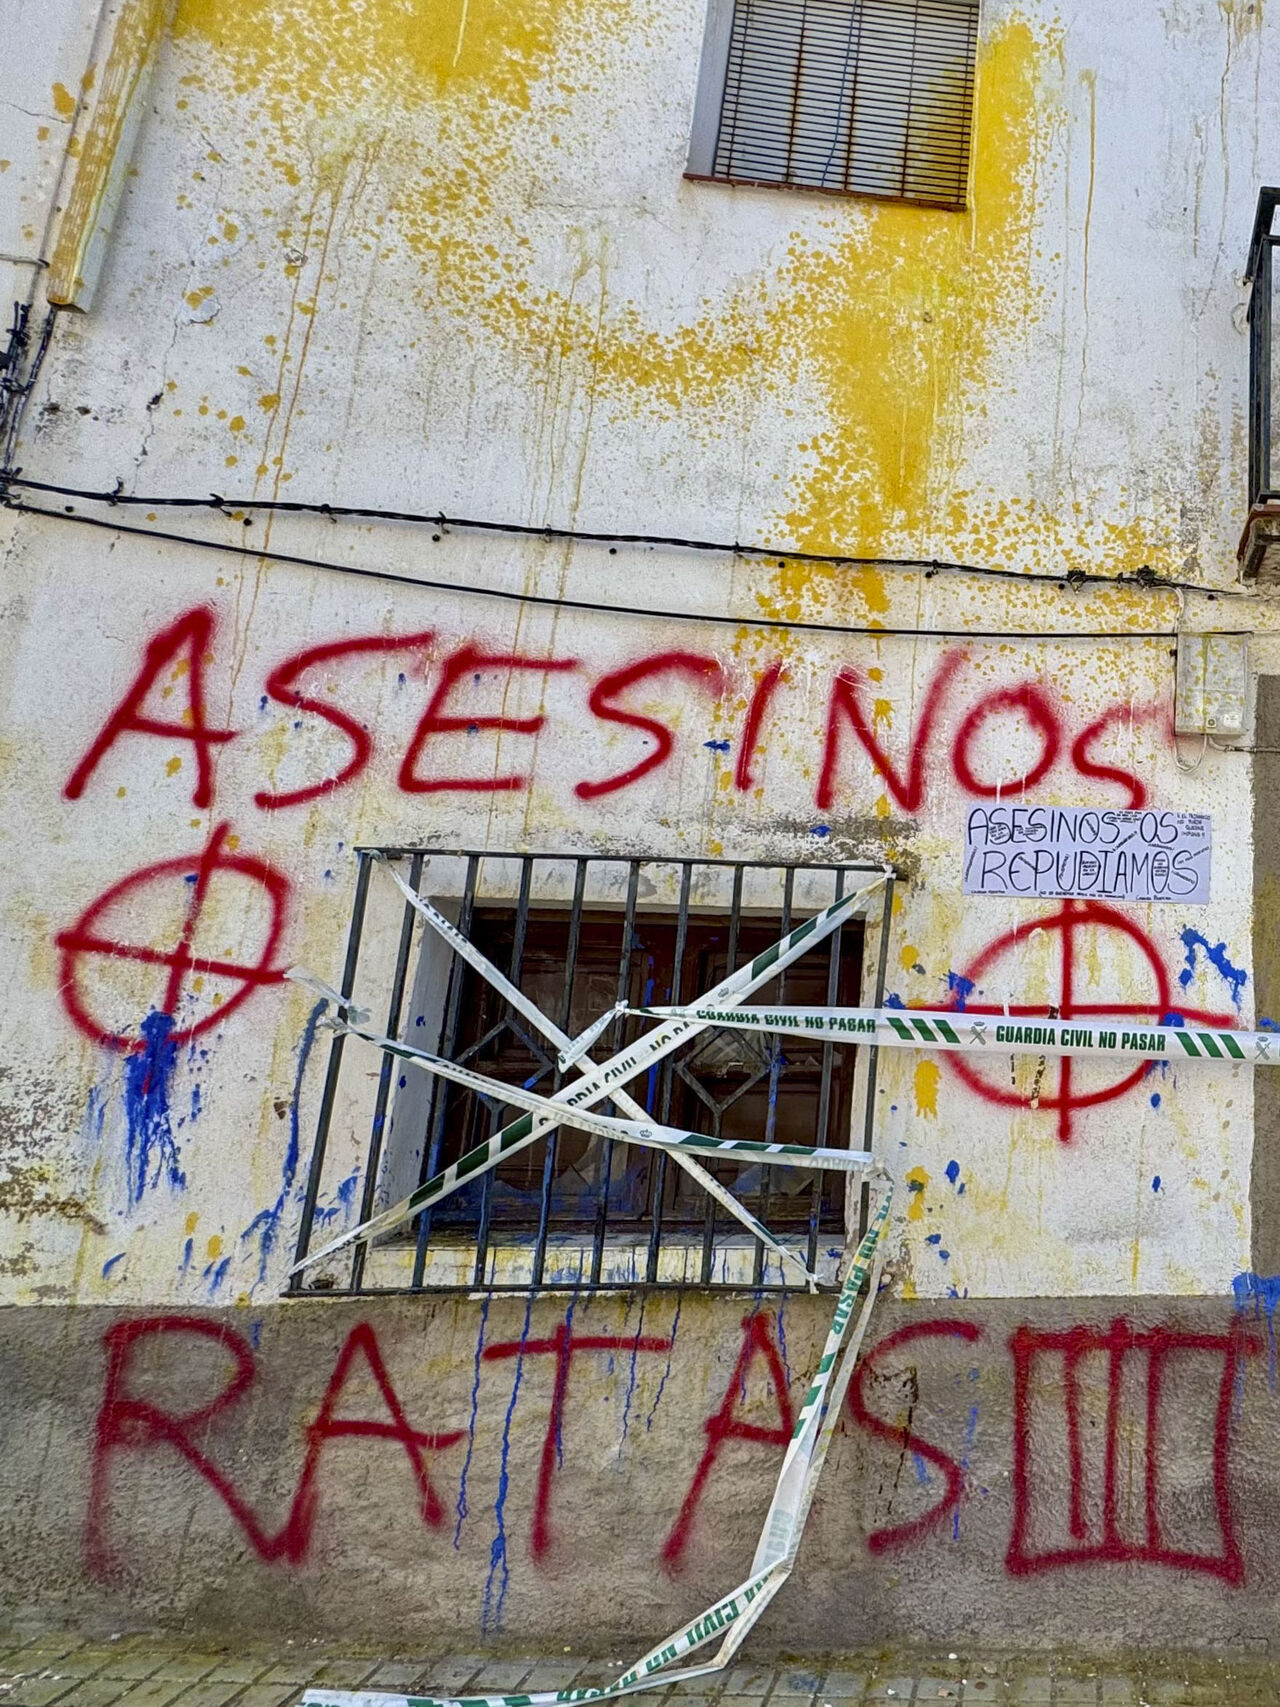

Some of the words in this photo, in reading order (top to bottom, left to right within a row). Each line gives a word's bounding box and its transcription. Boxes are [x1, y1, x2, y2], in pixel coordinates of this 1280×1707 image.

[62, 602, 1172, 814] ASESINOS
[968, 807, 1121, 845] ASESINOS
[1139, 811, 1179, 845] OS
[980, 849, 1199, 895] REPUDIAMOS
[804, 1016, 824, 1029] NO
[828, 1018, 877, 1033] PASAR
[995, 1025, 1056, 1046] GUARDIA
[1060, 1029, 1094, 1048] CIVIL
[1099, 1030, 1117, 1049] NO
[1121, 1032, 1167, 1051] PASAR
[829, 1264, 868, 1336] PASAR
[84, 1311, 982, 1590] RATAS
